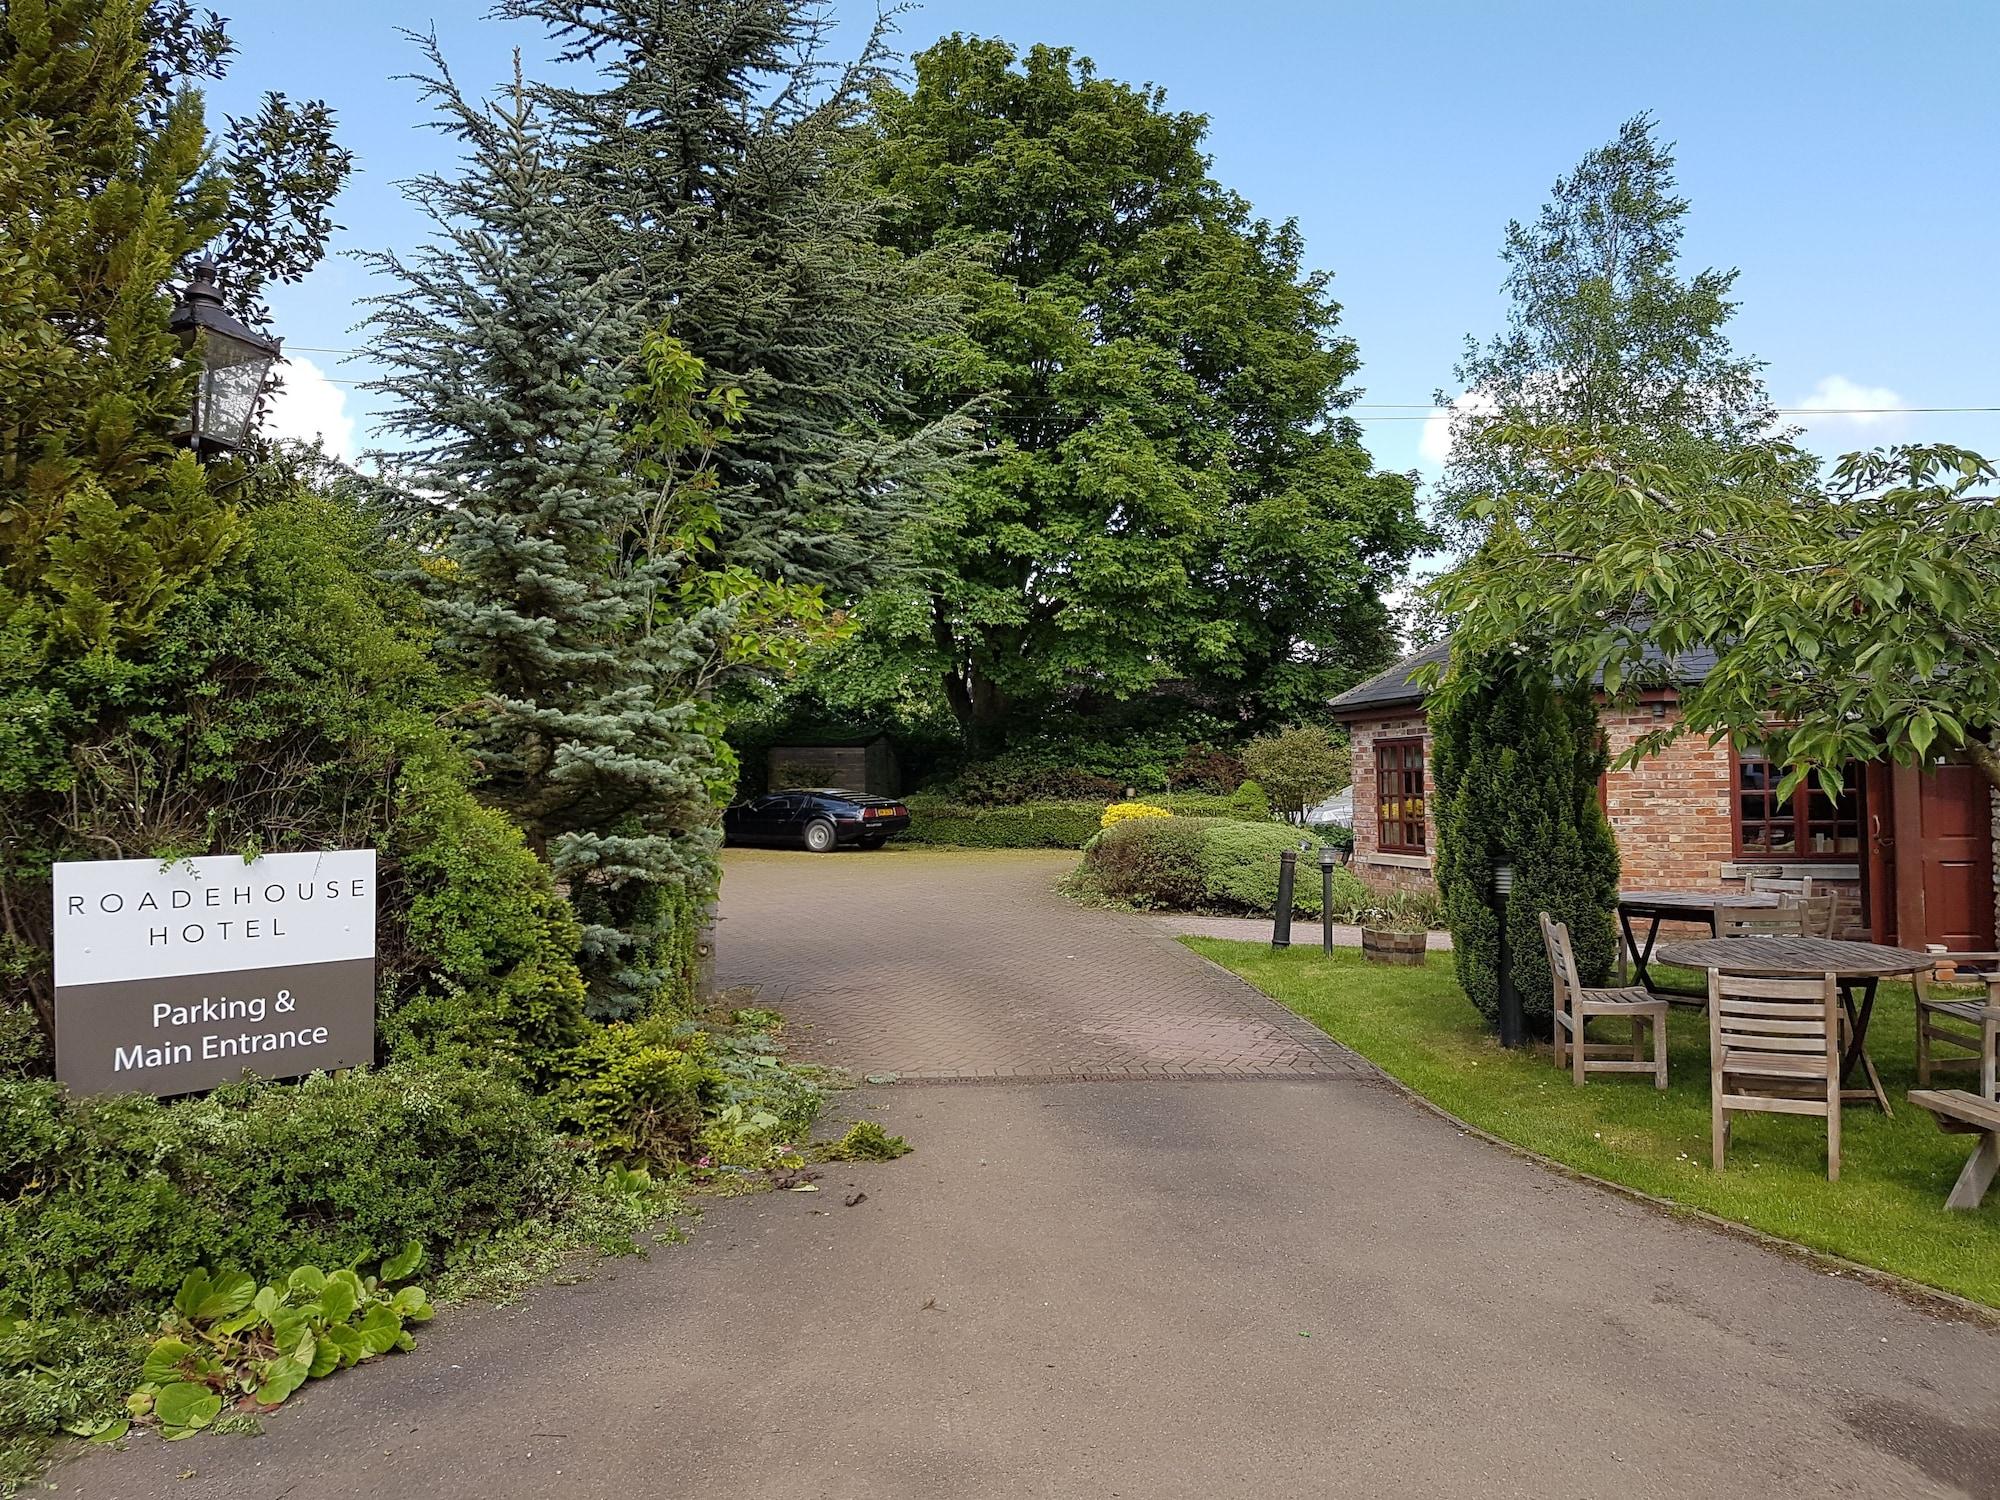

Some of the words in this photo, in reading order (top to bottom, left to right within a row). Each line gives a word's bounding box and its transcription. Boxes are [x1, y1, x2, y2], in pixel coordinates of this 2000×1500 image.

[68, 879, 365, 915] ROADEHOUSE
[149, 918, 286, 946] HOTEL
[152, 996, 266, 1028] Parking
[274, 989, 296, 1013] &
[113, 1040, 192, 1072] Main
[202, 1026, 329, 1060] Entrance
